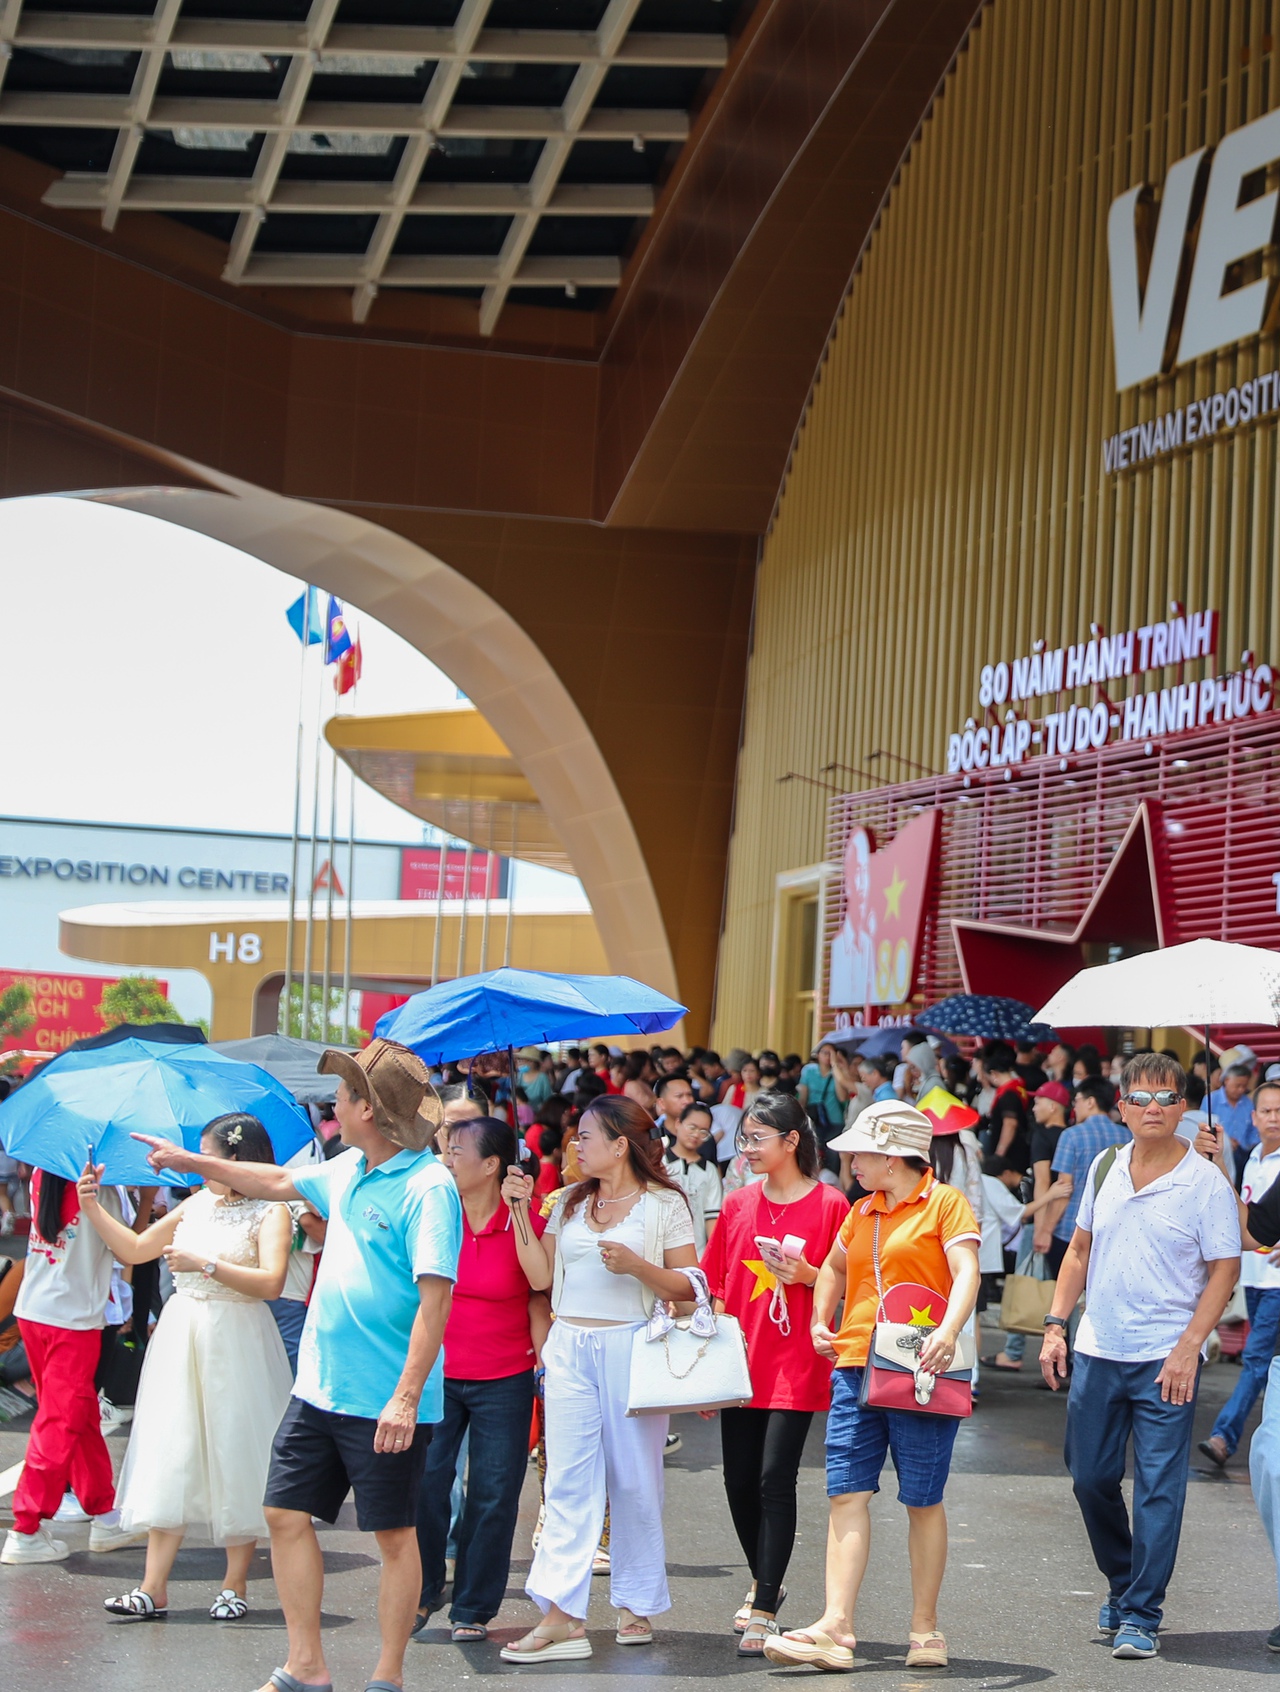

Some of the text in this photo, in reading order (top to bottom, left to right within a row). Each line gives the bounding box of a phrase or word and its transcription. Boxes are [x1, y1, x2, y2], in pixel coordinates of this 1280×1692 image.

[1103, 409, 1183, 475] VIETNAM
[979, 600, 1214, 707] 80 NĂM HÀNH TRÌNH
[947, 716, 991, 789] ĐỘC
[989, 708, 1031, 782] LẬP
[1045, 703, 1077, 772] TỰ
[1074, 702, 1109, 752] DO
[1122, 681, 1198, 756] HẠNH
[1199, 649, 1273, 723] PHÚC
[178, 865, 290, 893] CENTER
[208, 931, 263, 963] H8
